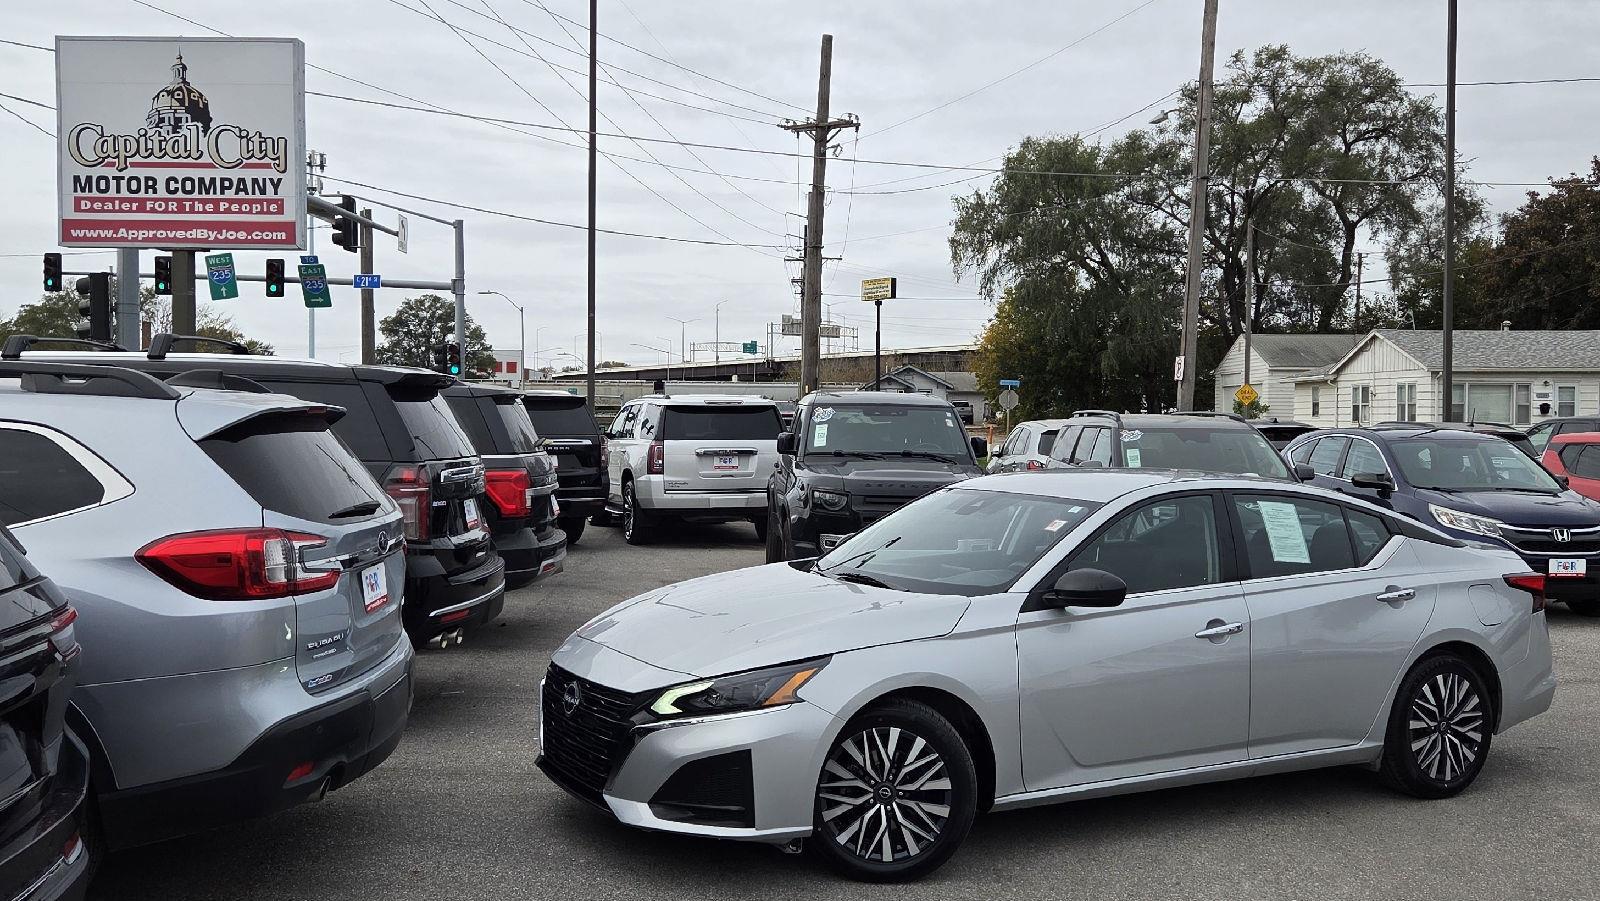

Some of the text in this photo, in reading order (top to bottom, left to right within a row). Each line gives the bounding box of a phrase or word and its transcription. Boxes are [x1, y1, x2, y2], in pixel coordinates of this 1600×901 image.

[68, 123, 287, 173] Capital City
[73, 175, 283, 196] MOTOR COMPANY
[80, 200, 280, 214] Dealer FOR The People
[70, 228, 287, 241] www.ApprovedByJoe.com
[208, 256, 230, 265] WEST
[212, 269, 231, 280] 235
[301, 266, 321, 274] EAST
[306, 280, 323, 289] 235
[306, 632, 345, 650] SUBARU
